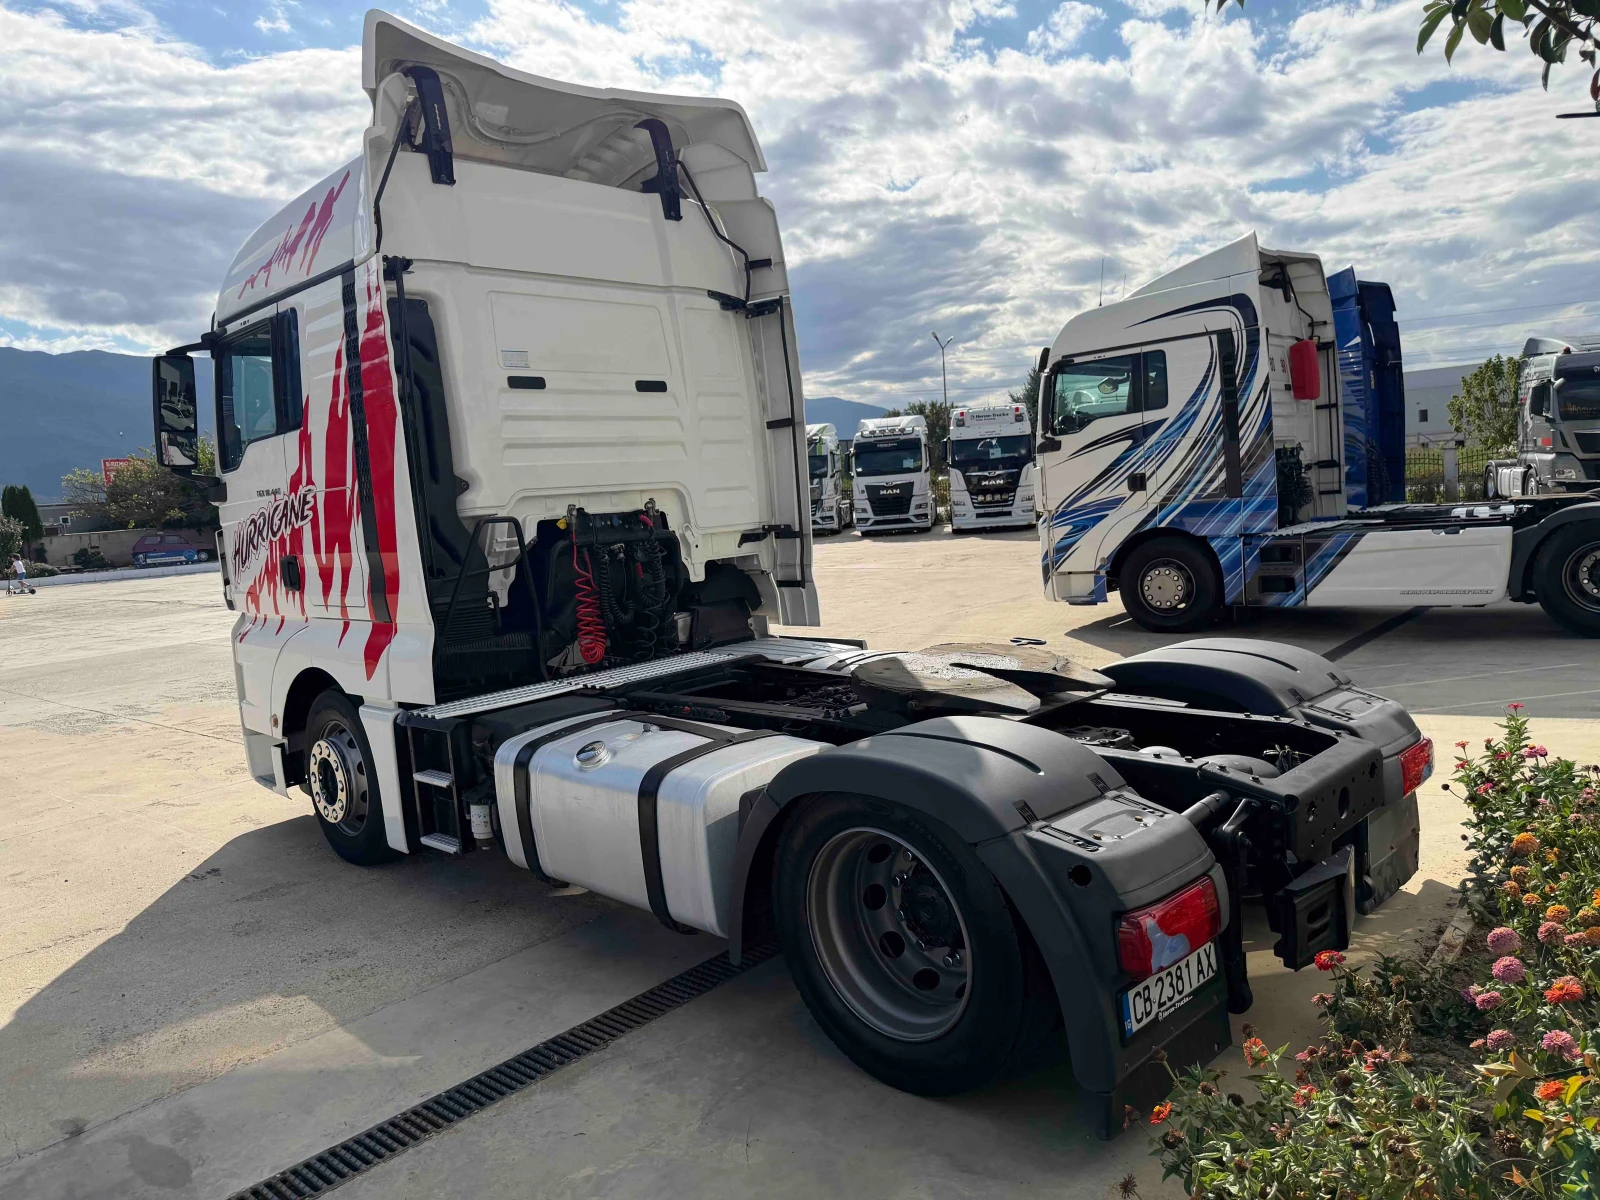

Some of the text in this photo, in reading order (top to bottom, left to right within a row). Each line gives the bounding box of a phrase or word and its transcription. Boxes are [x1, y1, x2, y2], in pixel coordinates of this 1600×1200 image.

[232, 485, 317, 588] HURRICANE
[1133, 945, 1215, 1024] CB 2381 AX
